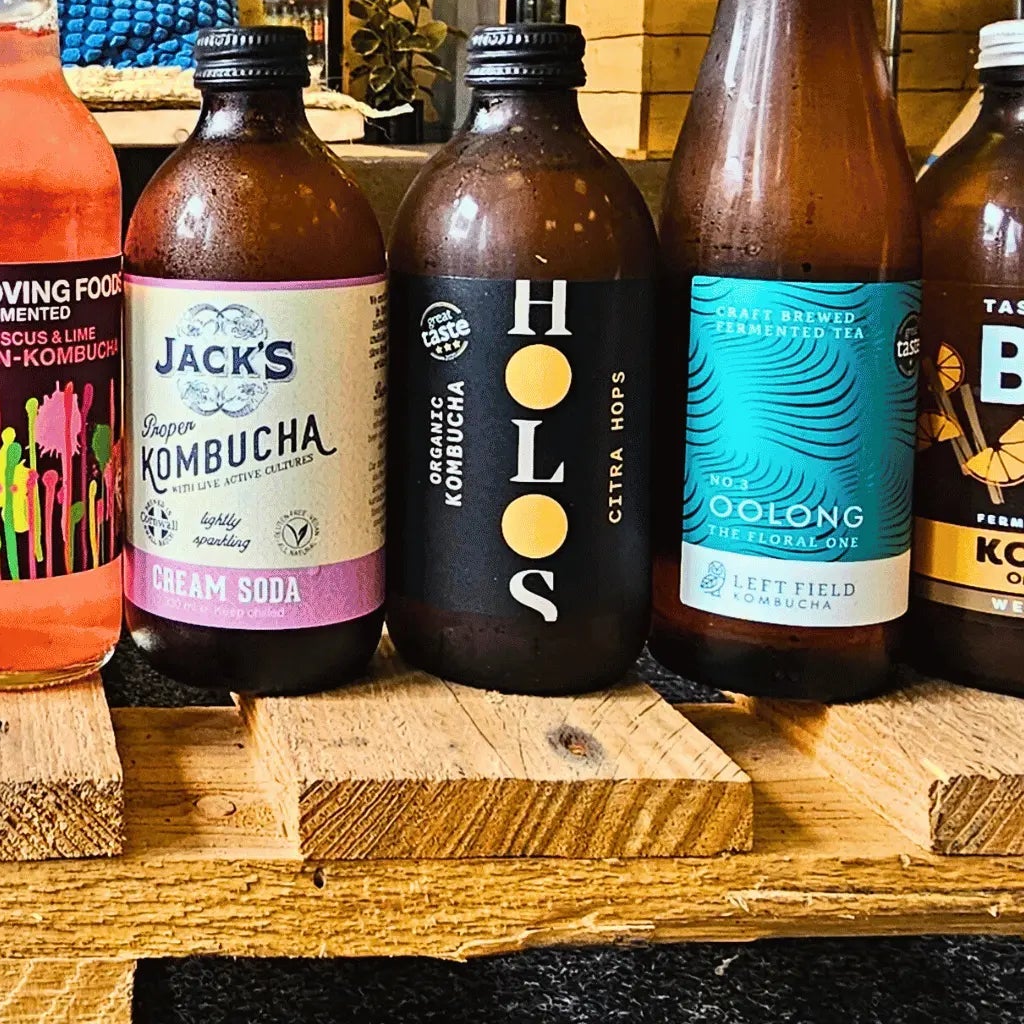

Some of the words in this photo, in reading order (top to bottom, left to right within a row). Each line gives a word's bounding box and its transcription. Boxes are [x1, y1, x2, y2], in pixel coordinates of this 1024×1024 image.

[716, 306, 773, 321] CRAFT
[781, 311, 856, 324] BREWED
[983, 298, 1024, 315] TAS
[427, 309, 454, 330] great
[716, 321, 826, 339] FERMENTED
[829, 327, 865, 340] TEA
[51, 329, 63, 344] &
[65, 326, 97, 344] LIME
[421, 318, 471, 348] taste
[155, 335, 296, 381] JACK'S
[897, 338, 921, 358] tas
[610, 371, 626, 431] HOPS
[141, 413, 196, 444] Proper
[429, 396, 444, 486] ORGANIC
[445, 380, 465, 508] KOMBUCHA
[141, 414, 338, 494] KOMBUCHA
[171, 482, 195, 494] WITH
[197, 478, 221, 491] LIVE
[223, 469, 262, 487] ACTIVE
[264, 453, 315, 475] CULTURES
[608, 447, 624, 524] CITRA
[200, 512, 242, 530] lightly
[709, 494, 864, 529] OOLONG
[977, 513, 1024, 529] FERM
[193, 533, 251, 553] sparkling
[708, 524, 741, 539] THE
[747, 531, 818, 549] FLORAL
[826, 537, 859, 549] ONE
[152, 564, 227, 603] CREAM
[238, 576, 302, 605] SODA
[733, 575, 788, 594] LEFT
[795, 582, 856, 597] FIELD
[1006, 571, 1024, 586] O
[733, 593, 832, 610] KOMBUCHA
